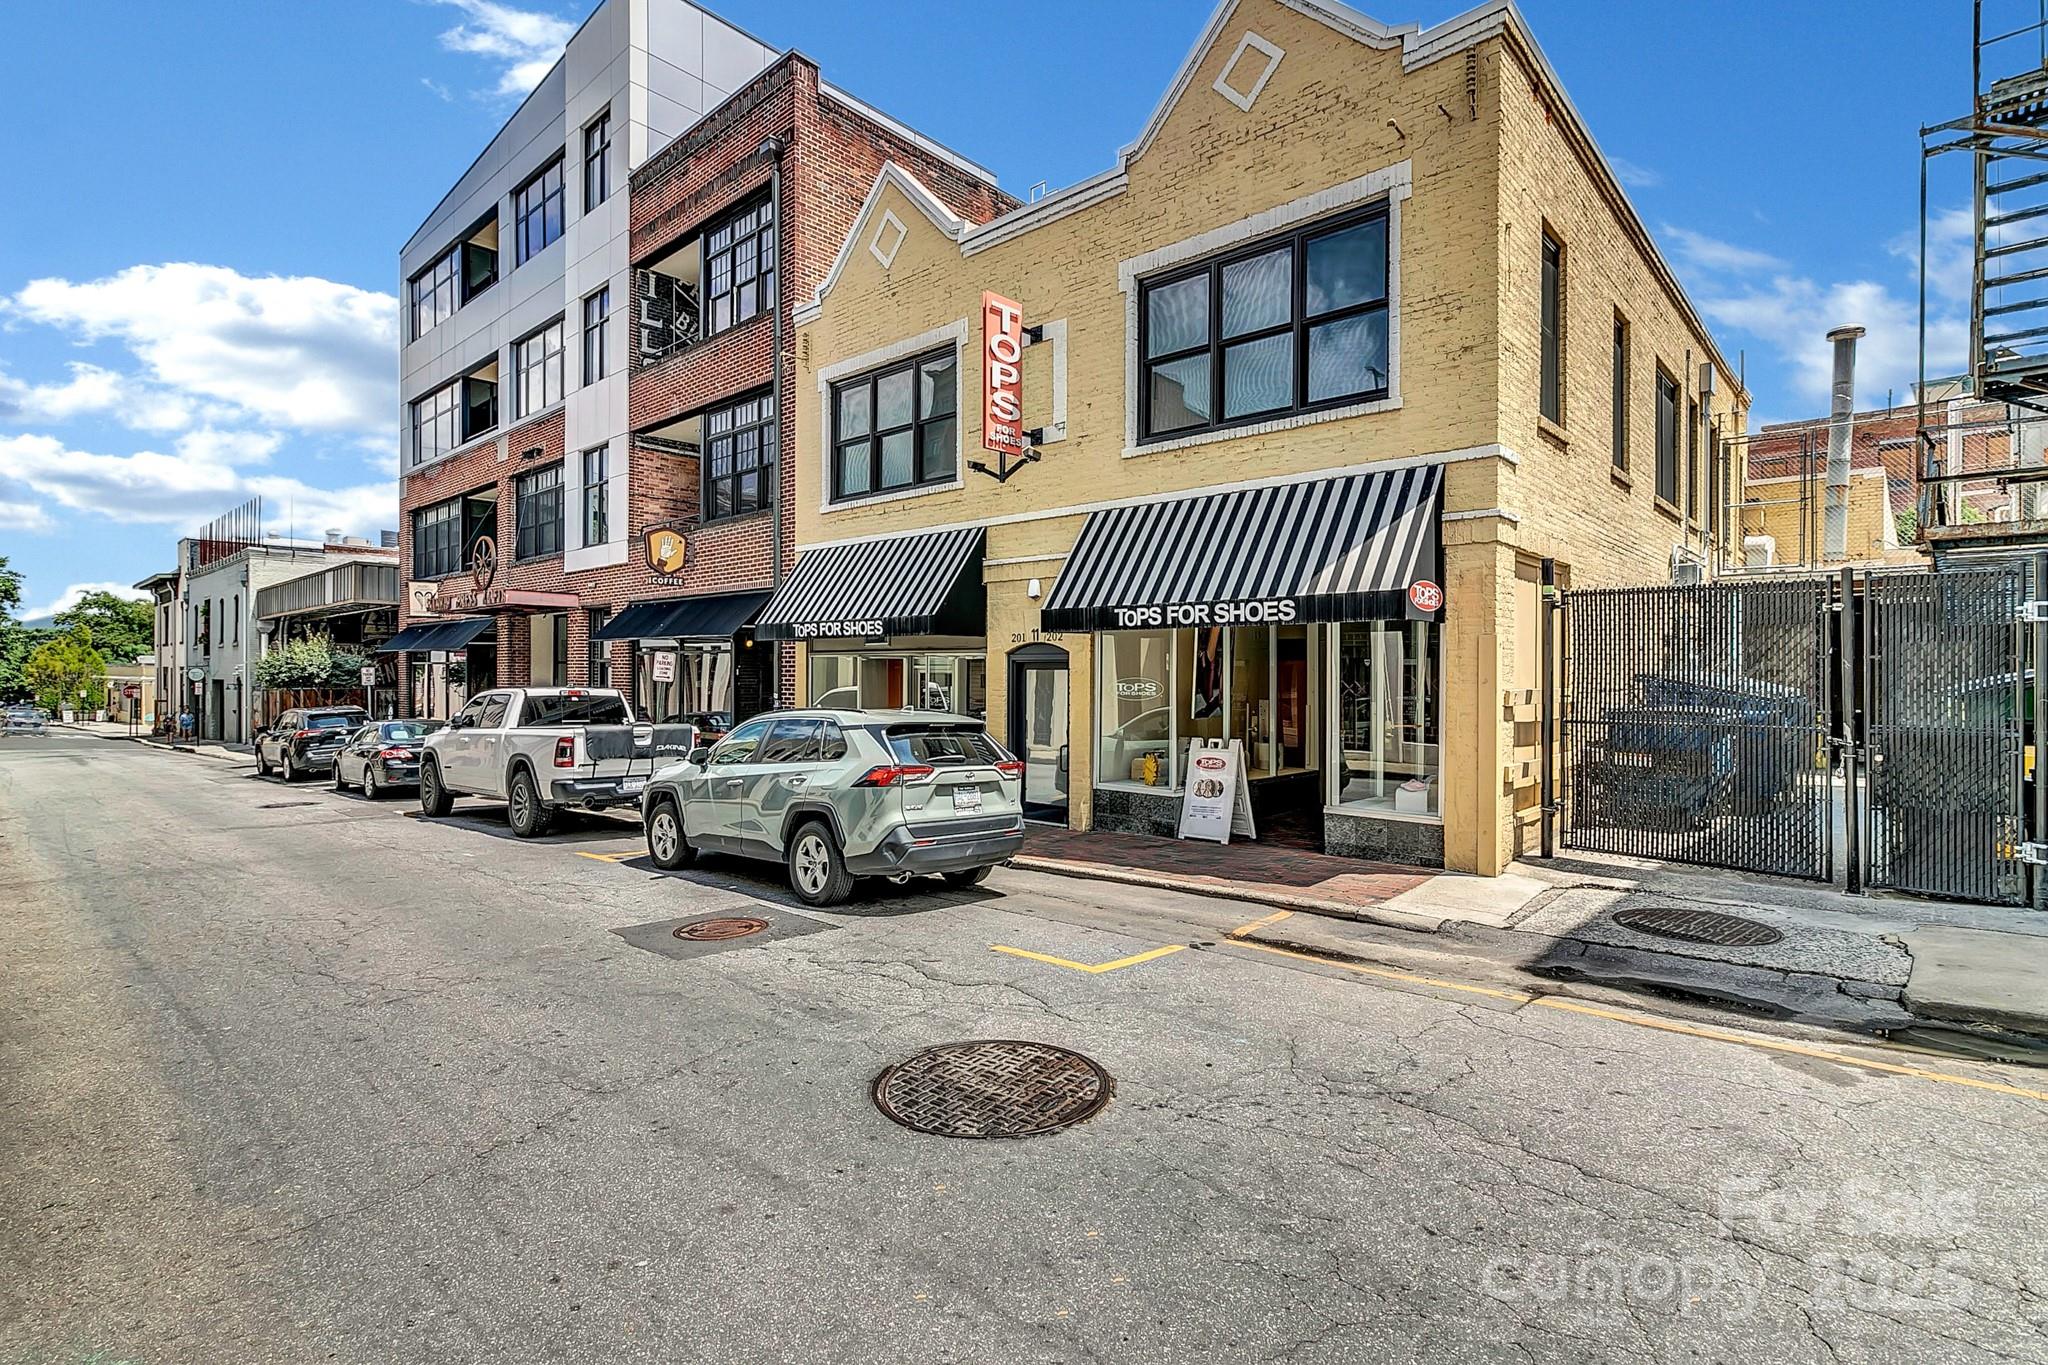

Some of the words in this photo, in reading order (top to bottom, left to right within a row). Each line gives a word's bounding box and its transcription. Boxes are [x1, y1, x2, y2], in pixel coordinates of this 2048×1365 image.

[990, 299, 1022, 422] TOPS
[996, 424, 1016, 436] FOR
[989, 431, 1022, 447] SHOES
[1114, 607, 1162, 627] TOPS
[1167, 605, 1211, 625] FOR
[1214, 599, 1296, 623] SHOES
[792, 623, 818, 637] TOPS
[820, 622, 842, 636] FOR
[843, 620, 883, 636] SHOES
[1011, 633, 1026, 643] 201
[1031, 628, 1040, 642] 11
[1046, 632, 1063, 641] 202
[1116, 683, 1157, 692] TOPS
